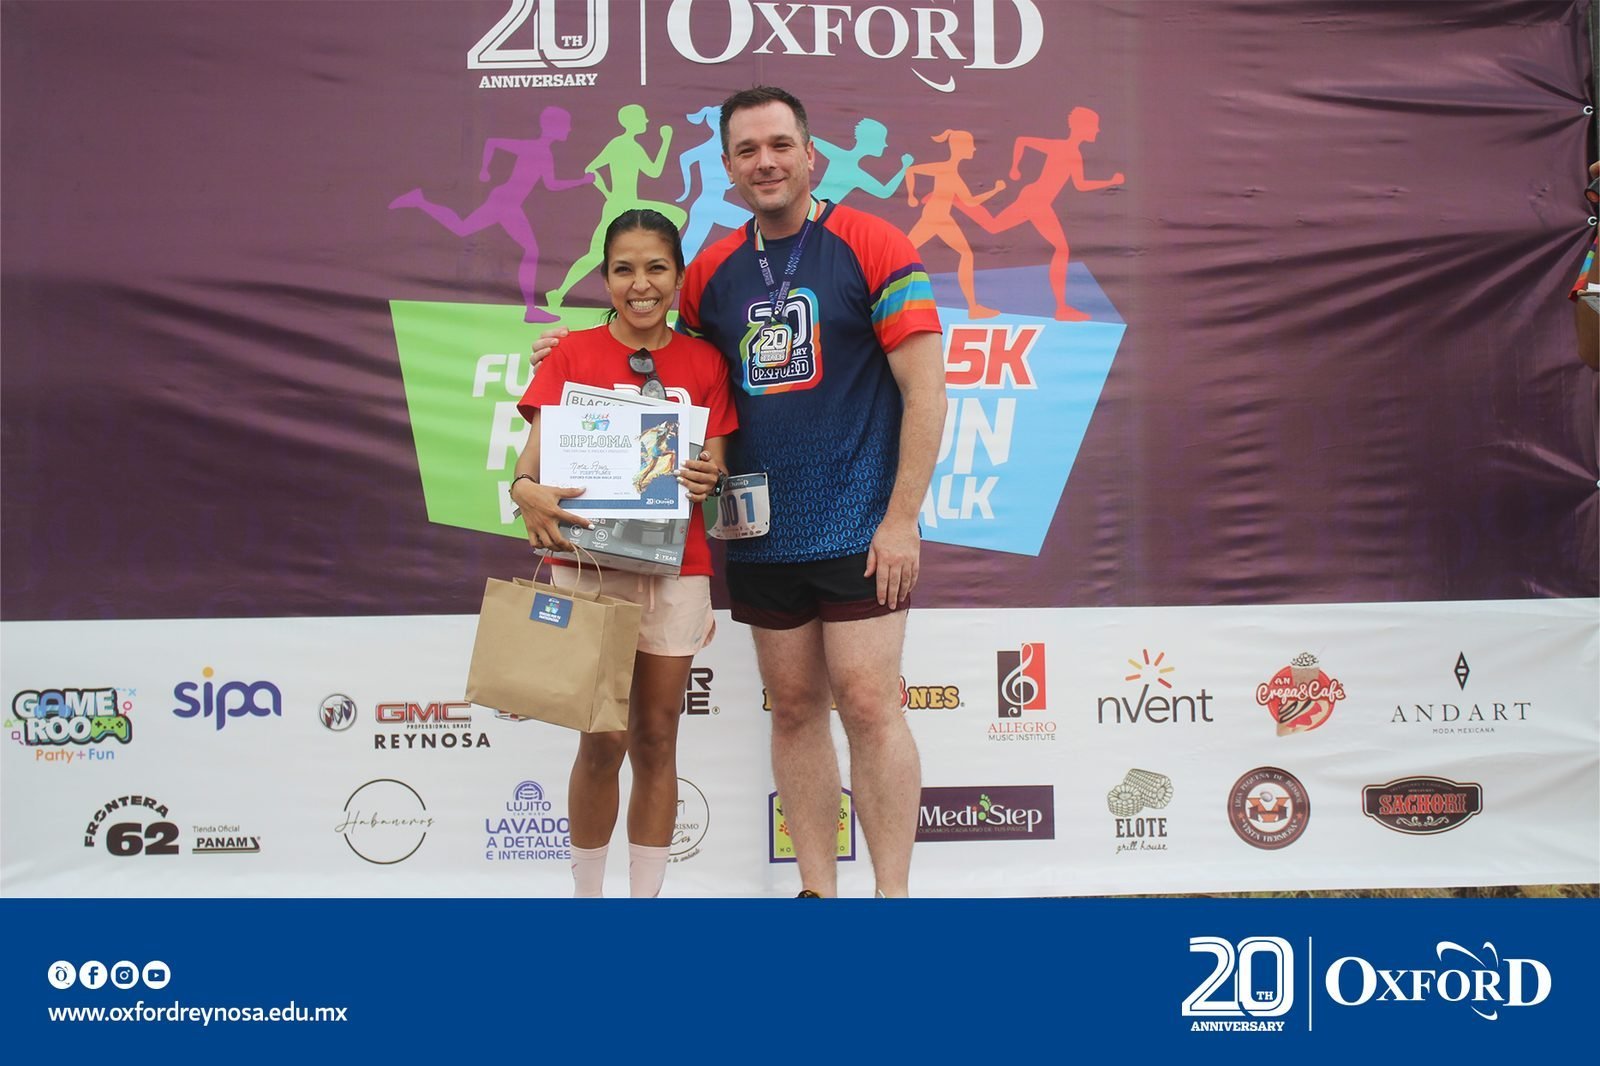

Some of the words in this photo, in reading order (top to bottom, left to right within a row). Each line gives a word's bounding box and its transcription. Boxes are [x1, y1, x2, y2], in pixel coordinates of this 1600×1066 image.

[467, 0, 609, 69] 20
[561, 35, 583, 48] TH
[666, 0, 1044, 70] OXFORD
[479, 73, 598, 89] ANNIVERSARY
[944, 325, 1046, 390] 5K
[559, 434, 632, 448] DIPLOMA
[12, 688, 118, 720] GAME
[172, 666, 282, 731] sipa
[375, 701, 472, 724] GMC
[1390, 702, 1532, 723] ANDART
[987, 721, 1056, 733] ALLEGRO
[988, 733, 1014, 741] MUSIC
[1015, 733, 1056, 741] INSTITUTE
[374, 732, 491, 749] REYNOSA
[506, 801, 552, 812] LUJITO
[1378, 793, 1468, 815] SACHORI
[84, 795, 169, 848] FRONTERA
[192, 825, 217, 833] Tienda
[217, 824, 240, 832] Oficial
[334, 811, 435, 834] Habaneros
[485, 818, 570, 834] LAVADO
[1115, 818, 1168, 839] ELOTE
[106, 821, 180, 857] 62
[486, 836, 498, 848] A
[504, 836, 570, 848] DETALLE
[486, 851, 494, 860] E
[498, 850, 572, 860] INTERIORES
